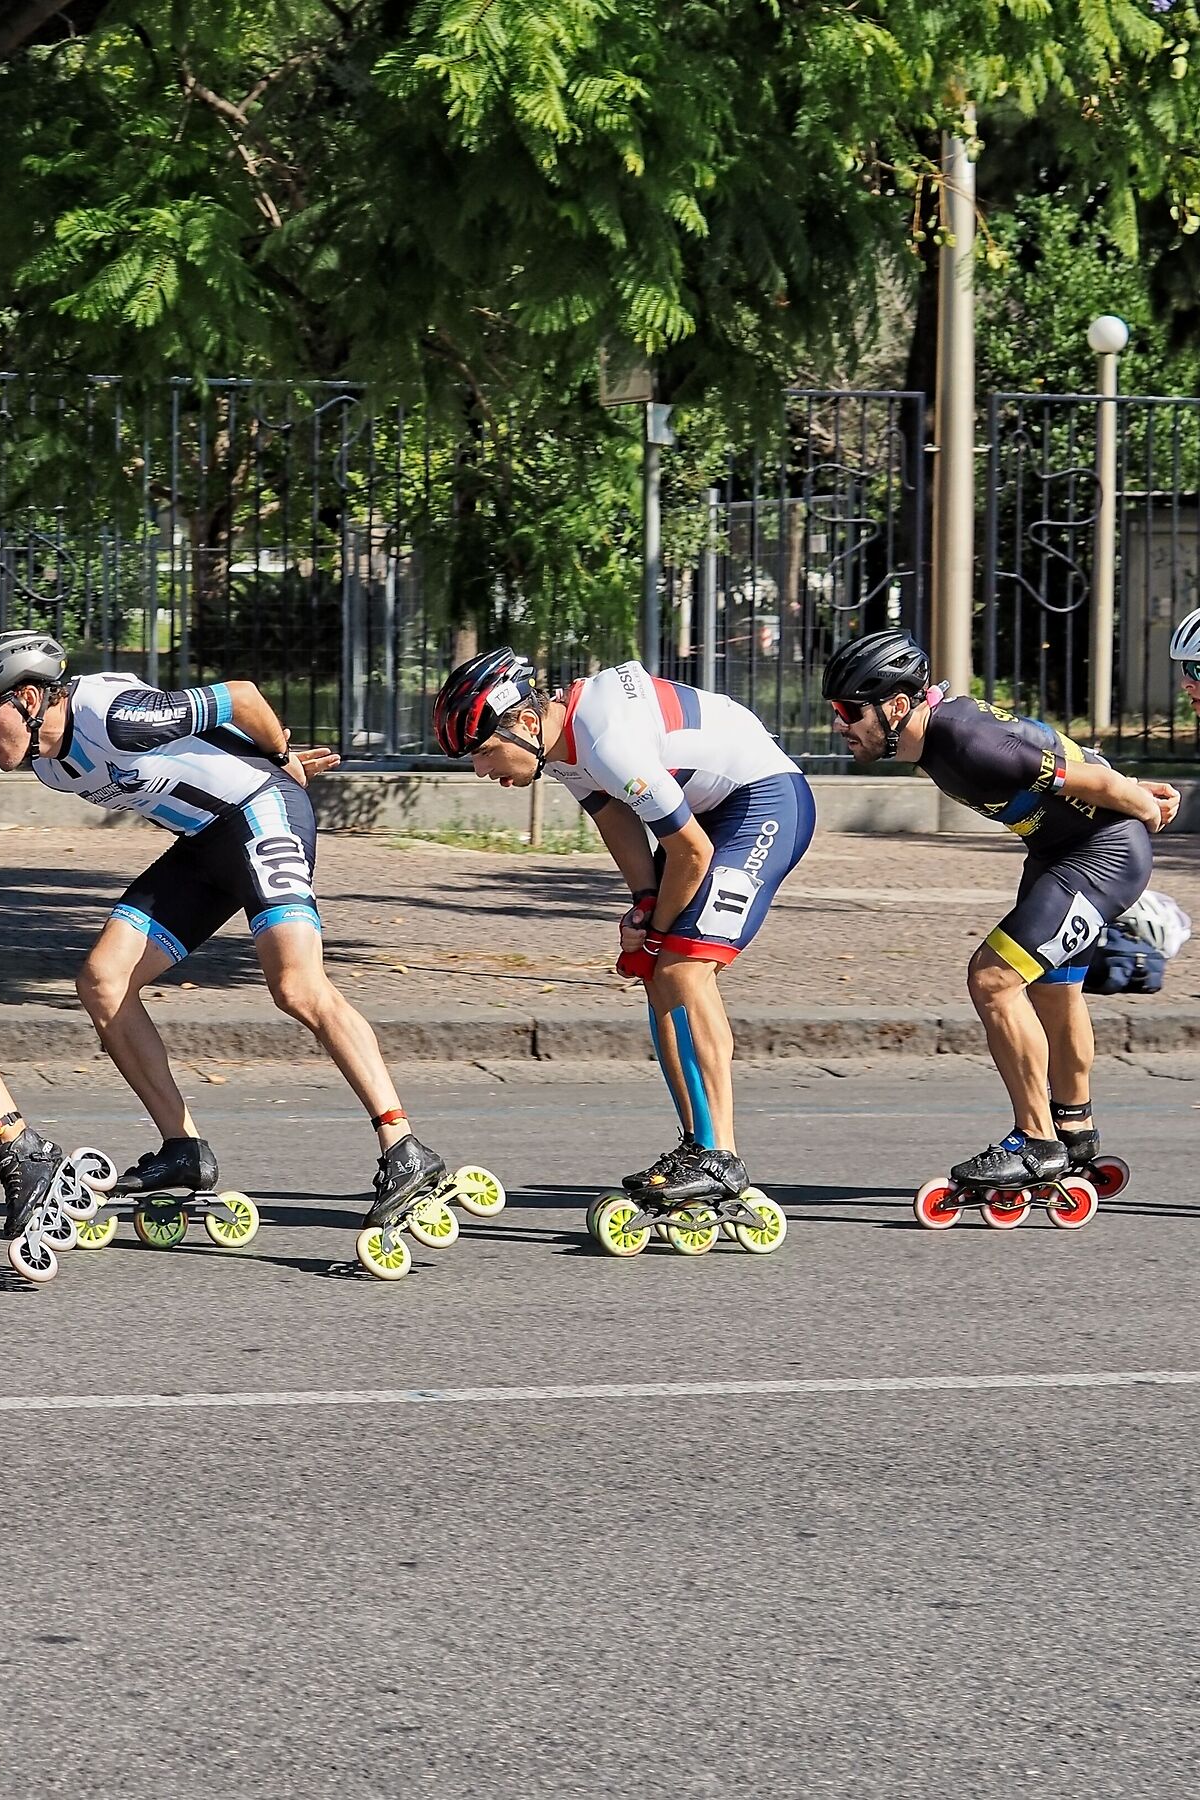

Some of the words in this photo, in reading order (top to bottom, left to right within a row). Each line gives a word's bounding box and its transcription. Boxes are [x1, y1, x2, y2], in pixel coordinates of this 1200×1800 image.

[111, 706, 188, 723] ANPINLINE
[85, 782, 122, 805] PINLINE
[255, 836, 312, 890] 210
[742, 819, 780, 878] USCO
[712, 888, 750, 916] 11
[1061, 915, 1090, 954] 69
